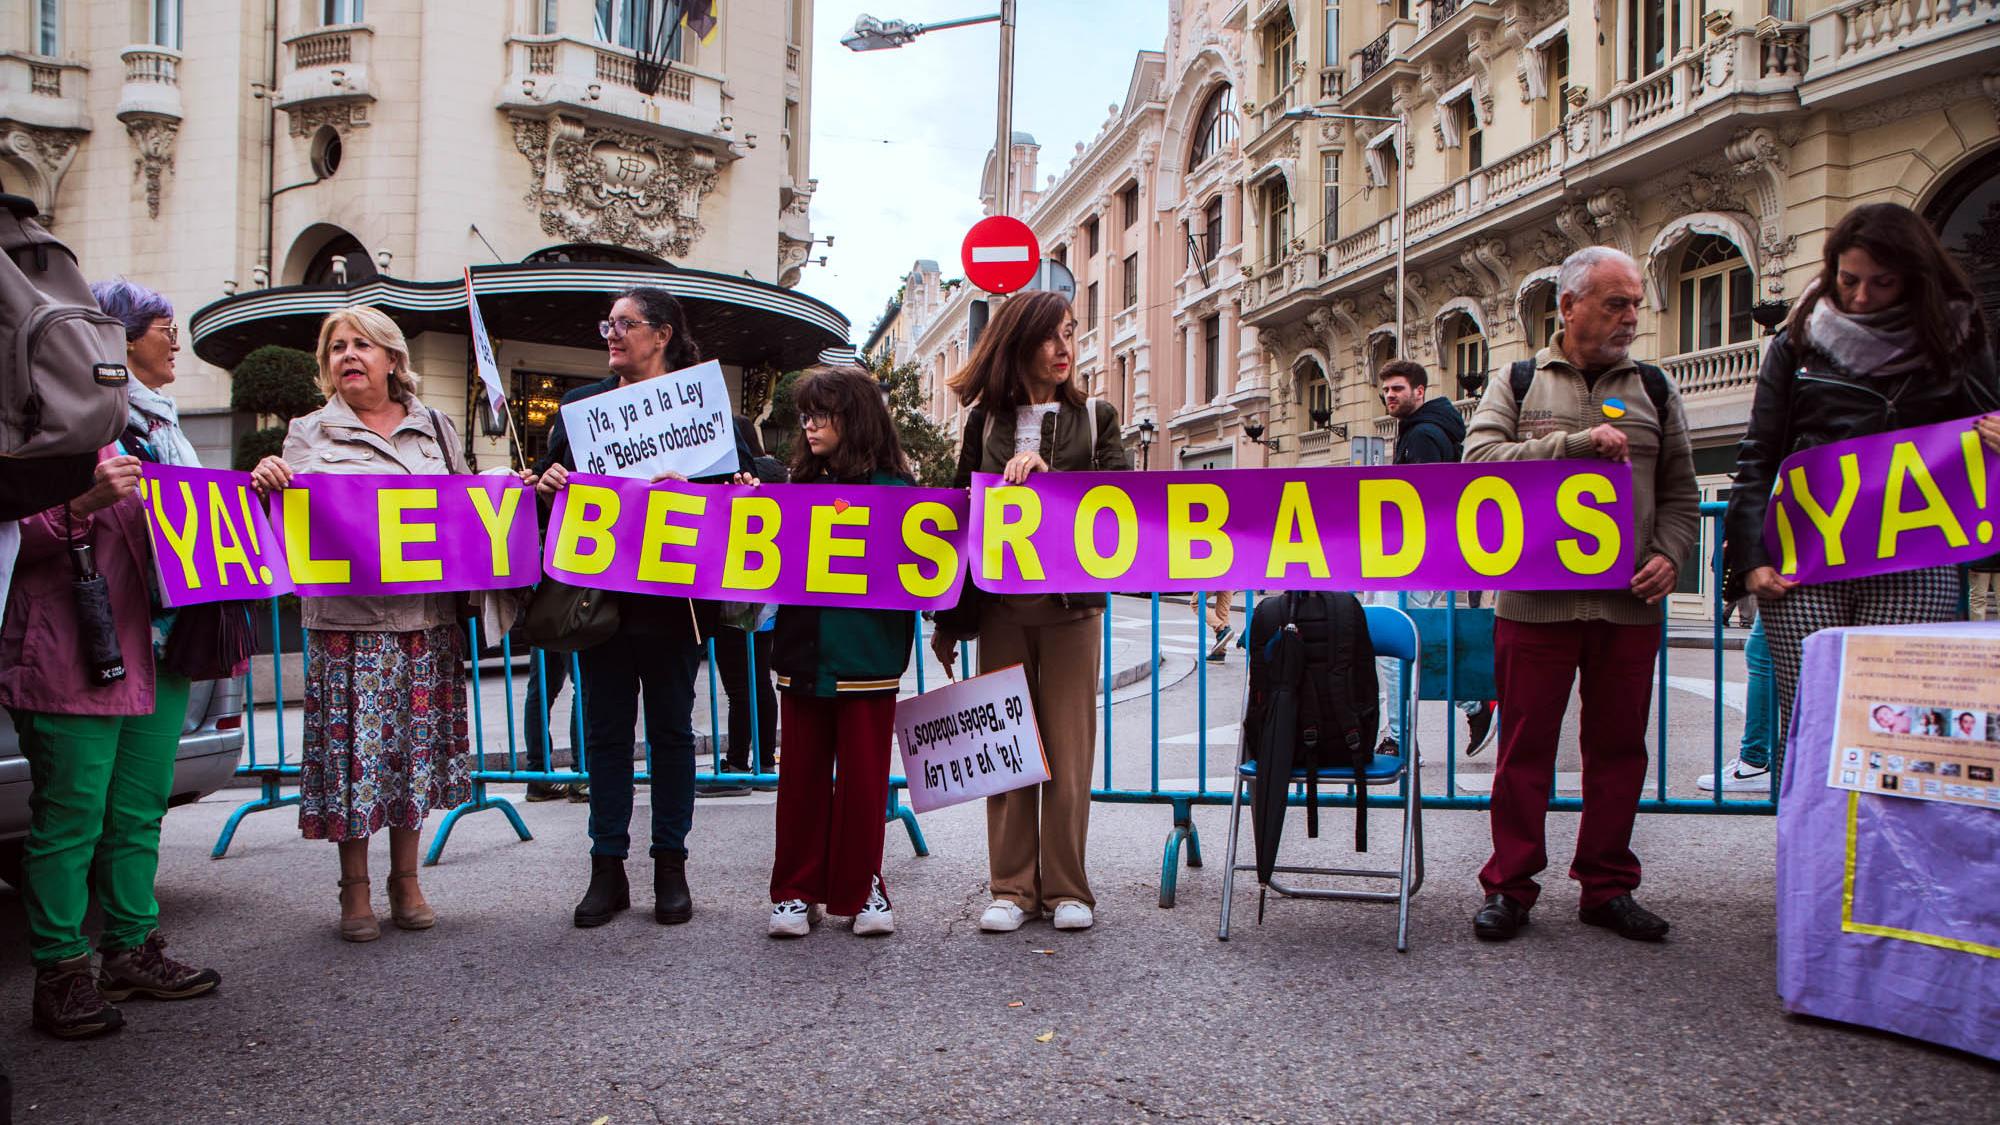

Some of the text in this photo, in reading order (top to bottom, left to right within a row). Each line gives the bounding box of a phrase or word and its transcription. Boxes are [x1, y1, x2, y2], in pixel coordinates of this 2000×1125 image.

[587, 381, 704, 442] ¡Ya, ya a la Ley
[587, 411, 726, 475] de "Bebés robados"!
[982, 473, 1621, 580] ROBADOS
[1773, 430, 1994, 575] ¡YA!
[283, 488, 522, 584] LEY
[905, 695, 1023, 756] de "Bebés robados"!
[924, 735, 1023, 791] ¡Ya, ya a la Ley
